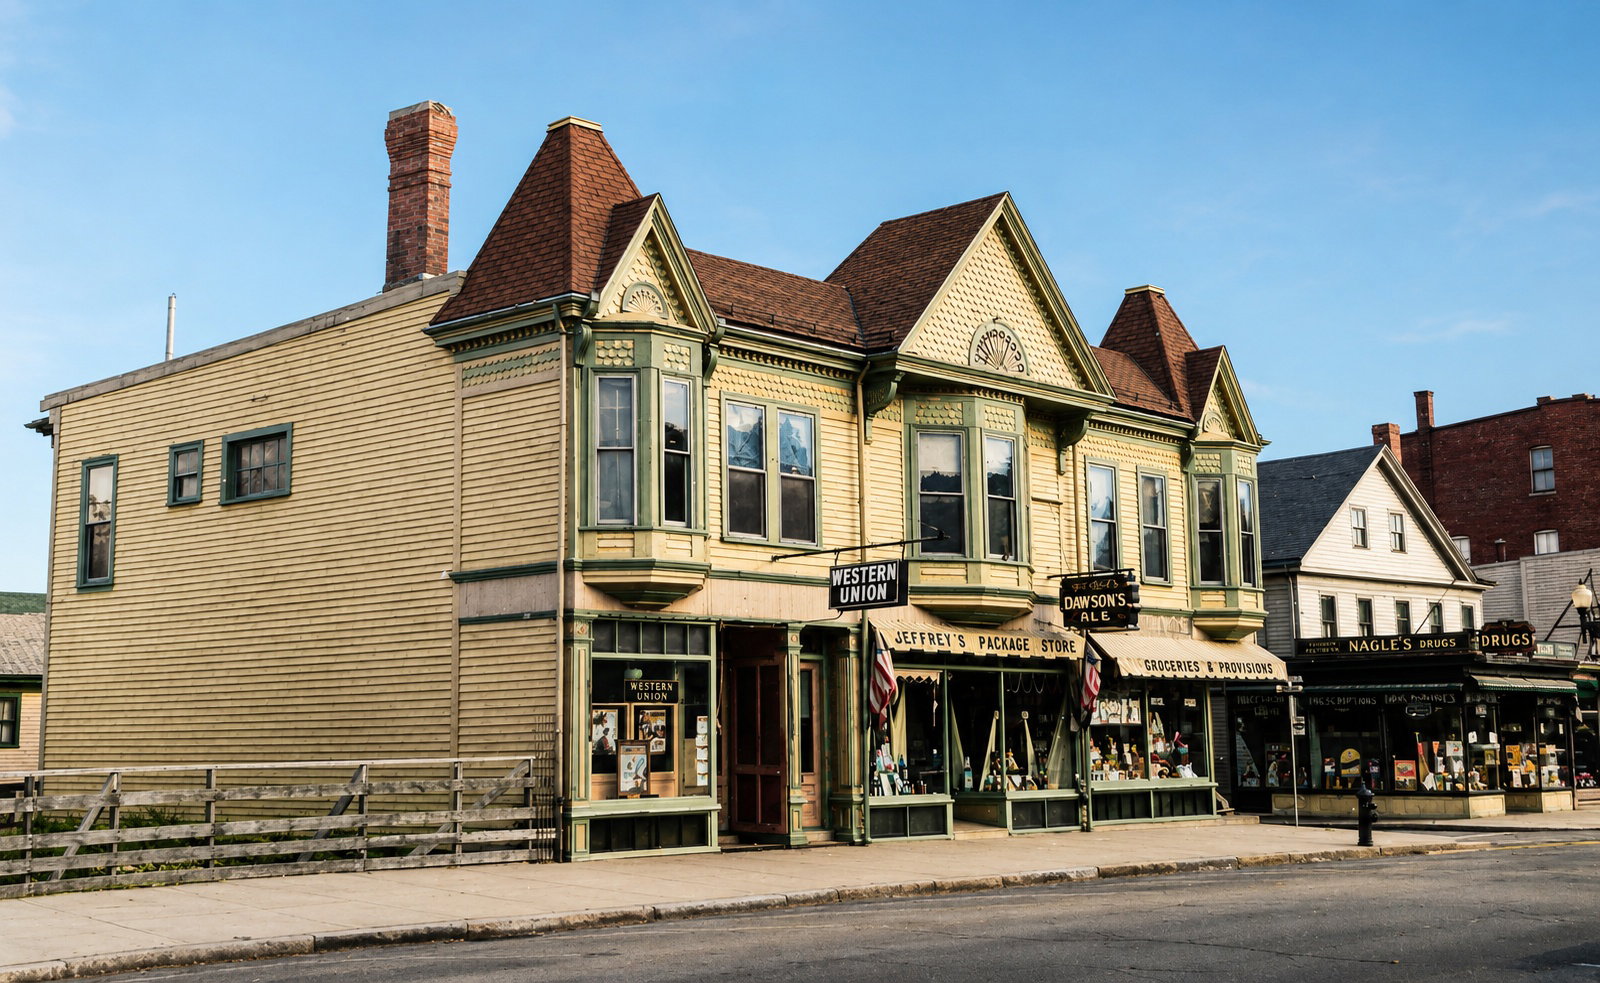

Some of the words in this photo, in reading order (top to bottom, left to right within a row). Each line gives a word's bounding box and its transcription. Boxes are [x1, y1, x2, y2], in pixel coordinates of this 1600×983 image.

[832, 563, 896, 586] WESTERN
[840, 583, 887, 603] UNION
[1064, 593, 1126, 610] DAWSON'S
[1081, 611, 1111, 622] ALE
[895, 631, 966, 648] JEFFREY'S
[979, 636, 1029, 651] PACKAGE
[1041, 639, 1077, 653] STORE
[1349, 637, 1412, 652] NAGLE'S
[1419, 638, 1456, 649] DRUGS
[1481, 633, 1530, 647] DRUGS
[1144, 659, 1200, 672] GROCERIES
[1207, 664, 1214, 673] &
[1219, 662, 1273, 675] PROVISIONS
[630, 682, 673, 691] WESTERN
[637, 692, 668, 701] UNION
